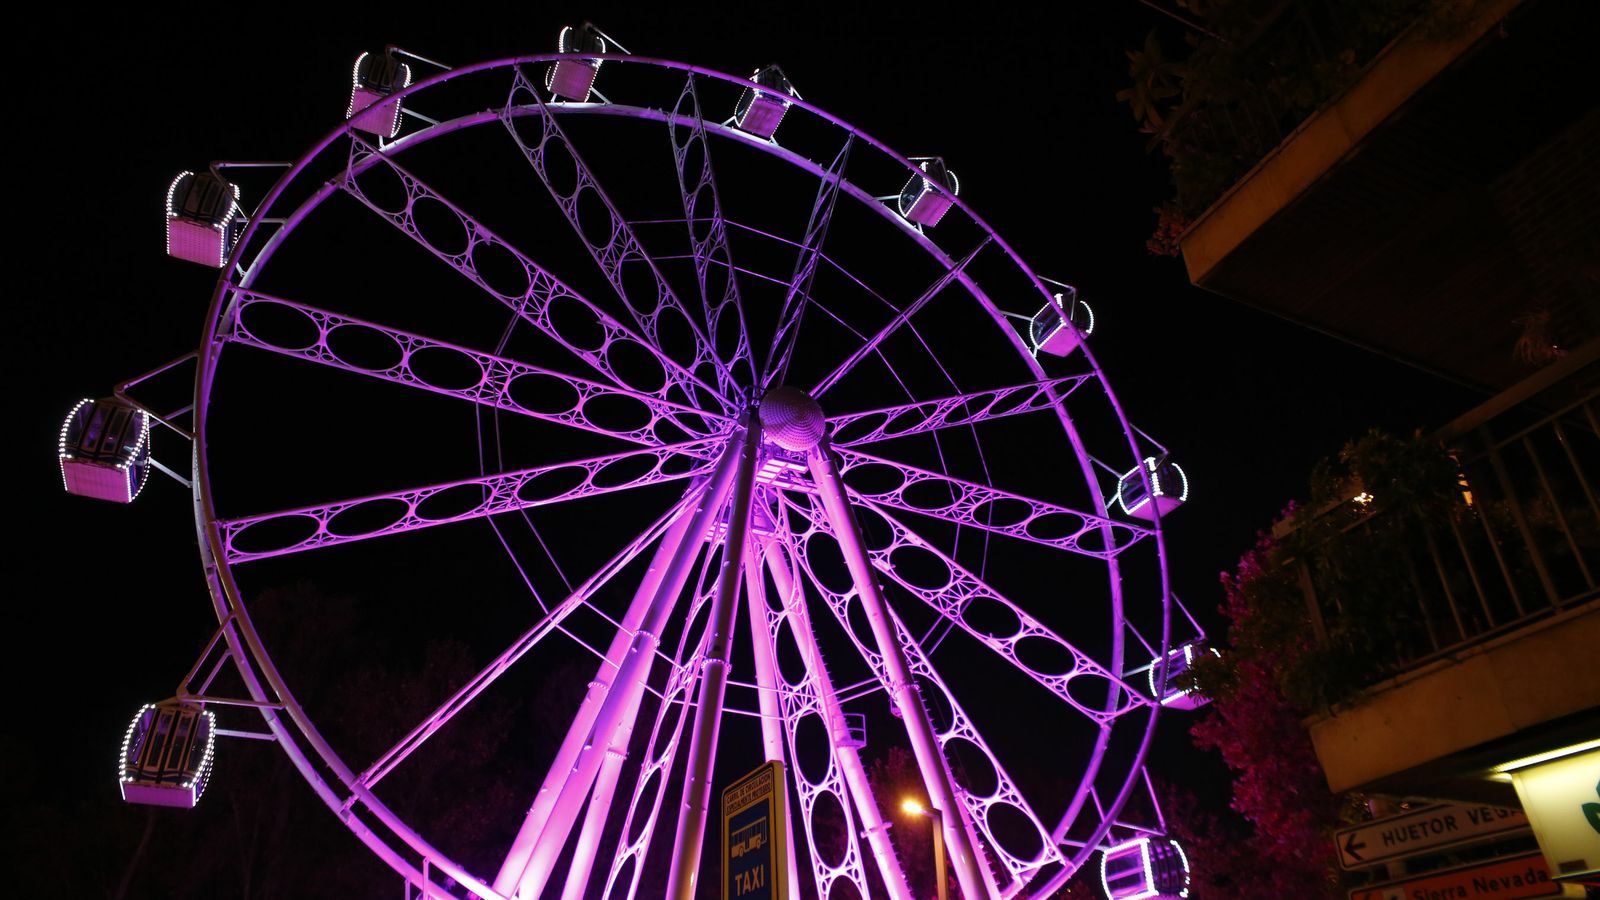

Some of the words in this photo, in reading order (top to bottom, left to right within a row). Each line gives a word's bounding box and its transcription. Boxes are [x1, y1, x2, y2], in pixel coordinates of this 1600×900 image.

[1382, 816, 1457, 847] HUETOR
[735, 864, 764, 897] TAXI
[1413, 886, 1466, 900] Sierra
[1473, 867, 1548, 893] Nevada
